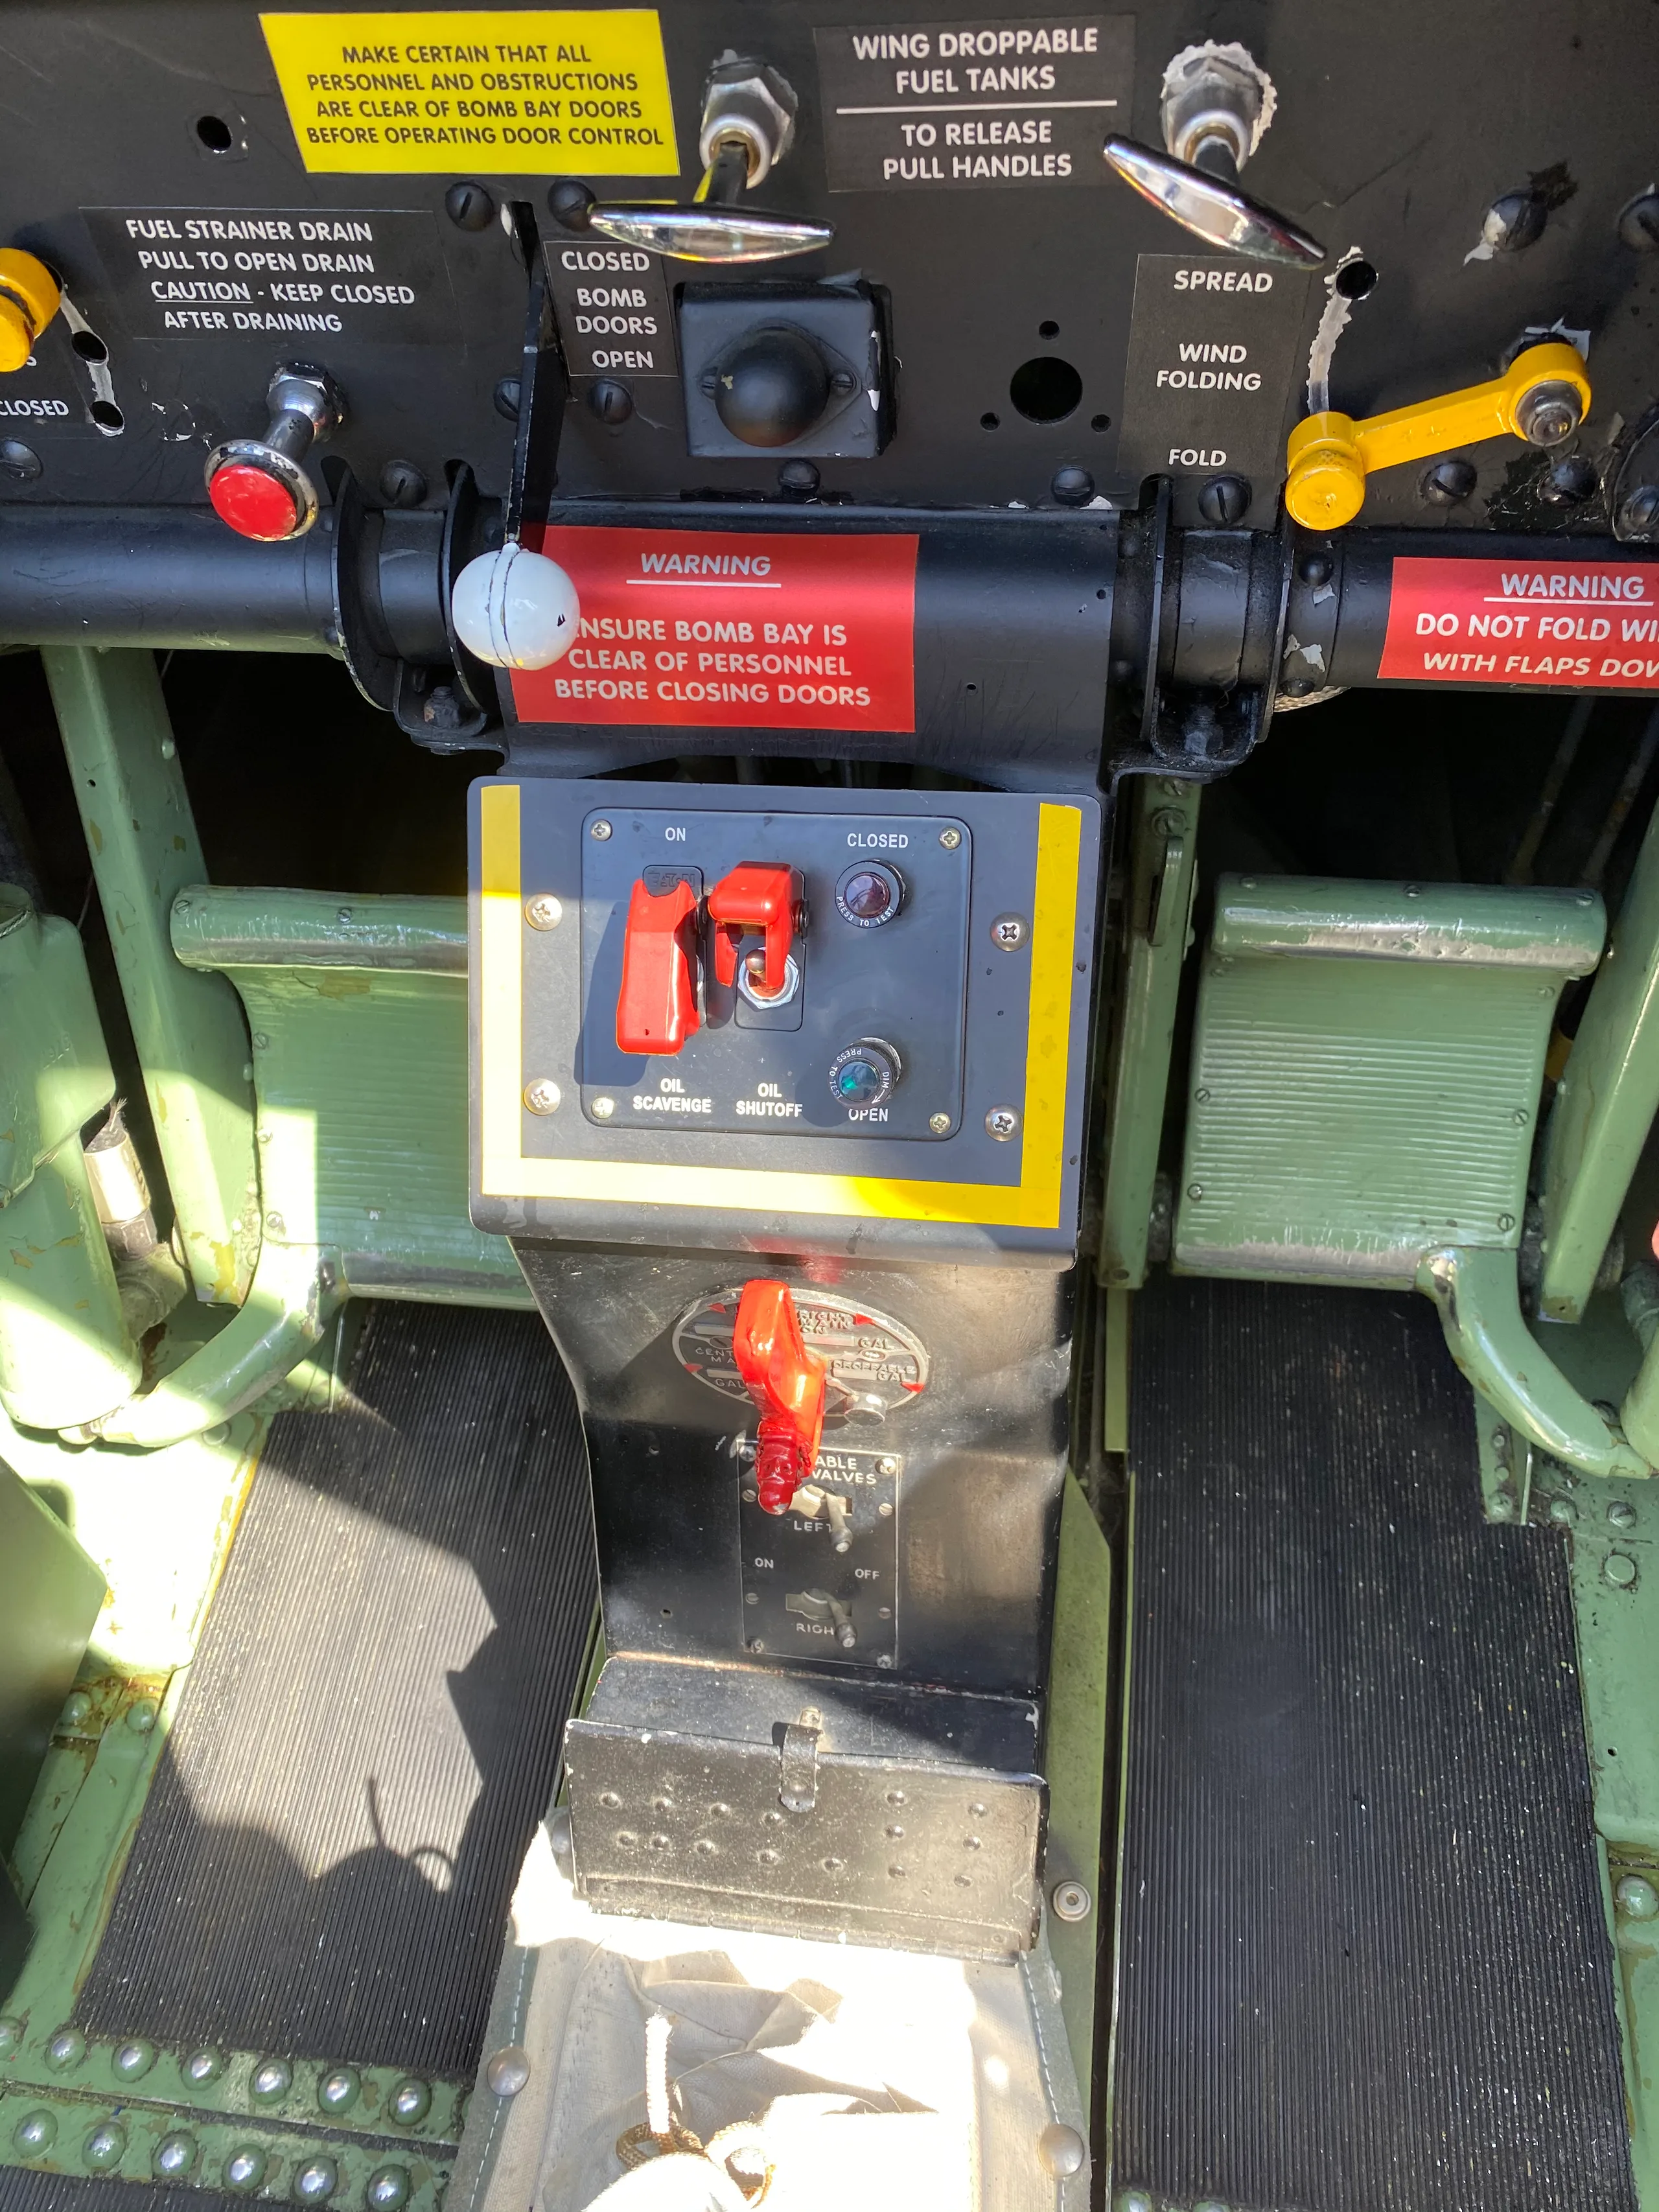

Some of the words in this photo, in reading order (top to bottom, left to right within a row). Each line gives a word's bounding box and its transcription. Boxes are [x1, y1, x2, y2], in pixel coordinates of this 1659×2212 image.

[852, 33, 930, 60] WING
[939, 27, 1098, 58] DROPPABLE
[342, 46, 399, 64] MAKE
[406, 45, 489, 64] CERTAIN
[495, 45, 547, 63] THAT
[557, 45, 591, 63] ALL
[307, 73, 424, 91] PERSONNEL
[432, 73, 474, 91] AND
[483, 73, 638, 91] OBSTRUCTIONS
[896, 69, 958, 94] FUEL
[966, 65, 1056, 91] TANKS
[317, 101, 353, 118] ARE
[360, 101, 419, 118] CLEAR
[425, 101, 450, 117] OF
[458, 101, 518, 118] BOMB
[525, 101, 561, 117] BAY
[570, 101, 642, 119] DOORS
[307, 128, 379, 144] BEFORE
[385, 128, 496, 145] OPERATING
[503, 128, 561, 145] DOOR
[568, 128, 664, 146] CONTROL
[901, 123, 936, 148] TO
[946, 120, 1052, 145] RELEASE
[883, 156, 944, 180] PULL
[953, 154, 1072, 179] HANDLES
[126, 220, 181, 239] FUEL
[185, 220, 295, 240] STRAINER
[299, 222, 373, 242] DRAIN
[138, 251, 194, 270] PULL
[196, 251, 228, 271] TO
[234, 251, 297, 272] OPEN
[303, 253, 375, 274] DRAIN
[561, 251, 650, 272] CLOSED
[1174, 270, 1273, 292] SPREAD
[151, 281, 251, 301] CAUTION
[270, 283, 323, 303] KEEP
[331, 284, 415, 305] CLOSED
[576, 288, 647, 307] BOMB
[165, 311, 229, 330] AFTER
[233, 312, 343, 332] DRAINING
[575, 316, 658, 335] DOORS
[592, 350, 654, 369] OPEN
[1179, 343, 1247, 364] WIND
[1156, 370, 1262, 391] FOLDING
[1168, 448, 1227, 467] FOLD
[641, 553, 771, 576] WARNING
[1502, 574, 1645, 599] WARNING
[576, 618, 666, 640] NSURE
[676, 621, 754, 643] BOMB
[763, 623, 815, 645] BAY
[824, 625, 847, 646] IS
[1416, 613, 1459, 636] DO
[1468, 614, 1530, 638] NOT
[1538, 617, 1611, 640] FOLD
[1621, 619, 1659, 642] WI
[568, 649, 647, 670] CLEAR
[655, 651, 688, 671] OF
[698, 654, 852, 677] PERSONNEL
[1424, 653, 1495, 672] WITH
[1505, 656, 1592, 676] FLAPS
[555, 679, 649, 700] BEFORE
[657, 681, 769, 703] CLOSING
[778, 684, 871, 706] DOORS
[666, 827, 686, 841] ON
[847, 833, 909, 848] CLOSED
[836, 896, 854, 921] PRESS
[876, 906, 894, 924] TEST
[837, 1048, 862, 1063] PRESS
[830, 1066, 838, 1076] TO
[660, 1078, 686, 1093] OIL
[758, 1082, 782, 1098] OIL
[830, 1080, 843, 1099] TEST
[632, 1095, 712, 1113] SCAVENGE
[736, 1100, 803, 1117] SHUTOFF
[848, 1108, 888, 1121] OPEN
[695, 1347, 734, 1356] CENT
[858, 1336, 894, 1349] GAL
[876, 1370, 912, 1382] GAL
[815, 1455, 857, 1470] ABLE
[812, 1469, 877, 1484] VALVES
[754, 1557, 774, 1569] ON
[855, 1568, 880, 1579] OFF
[796, 1623, 835, 1635] RIGH
